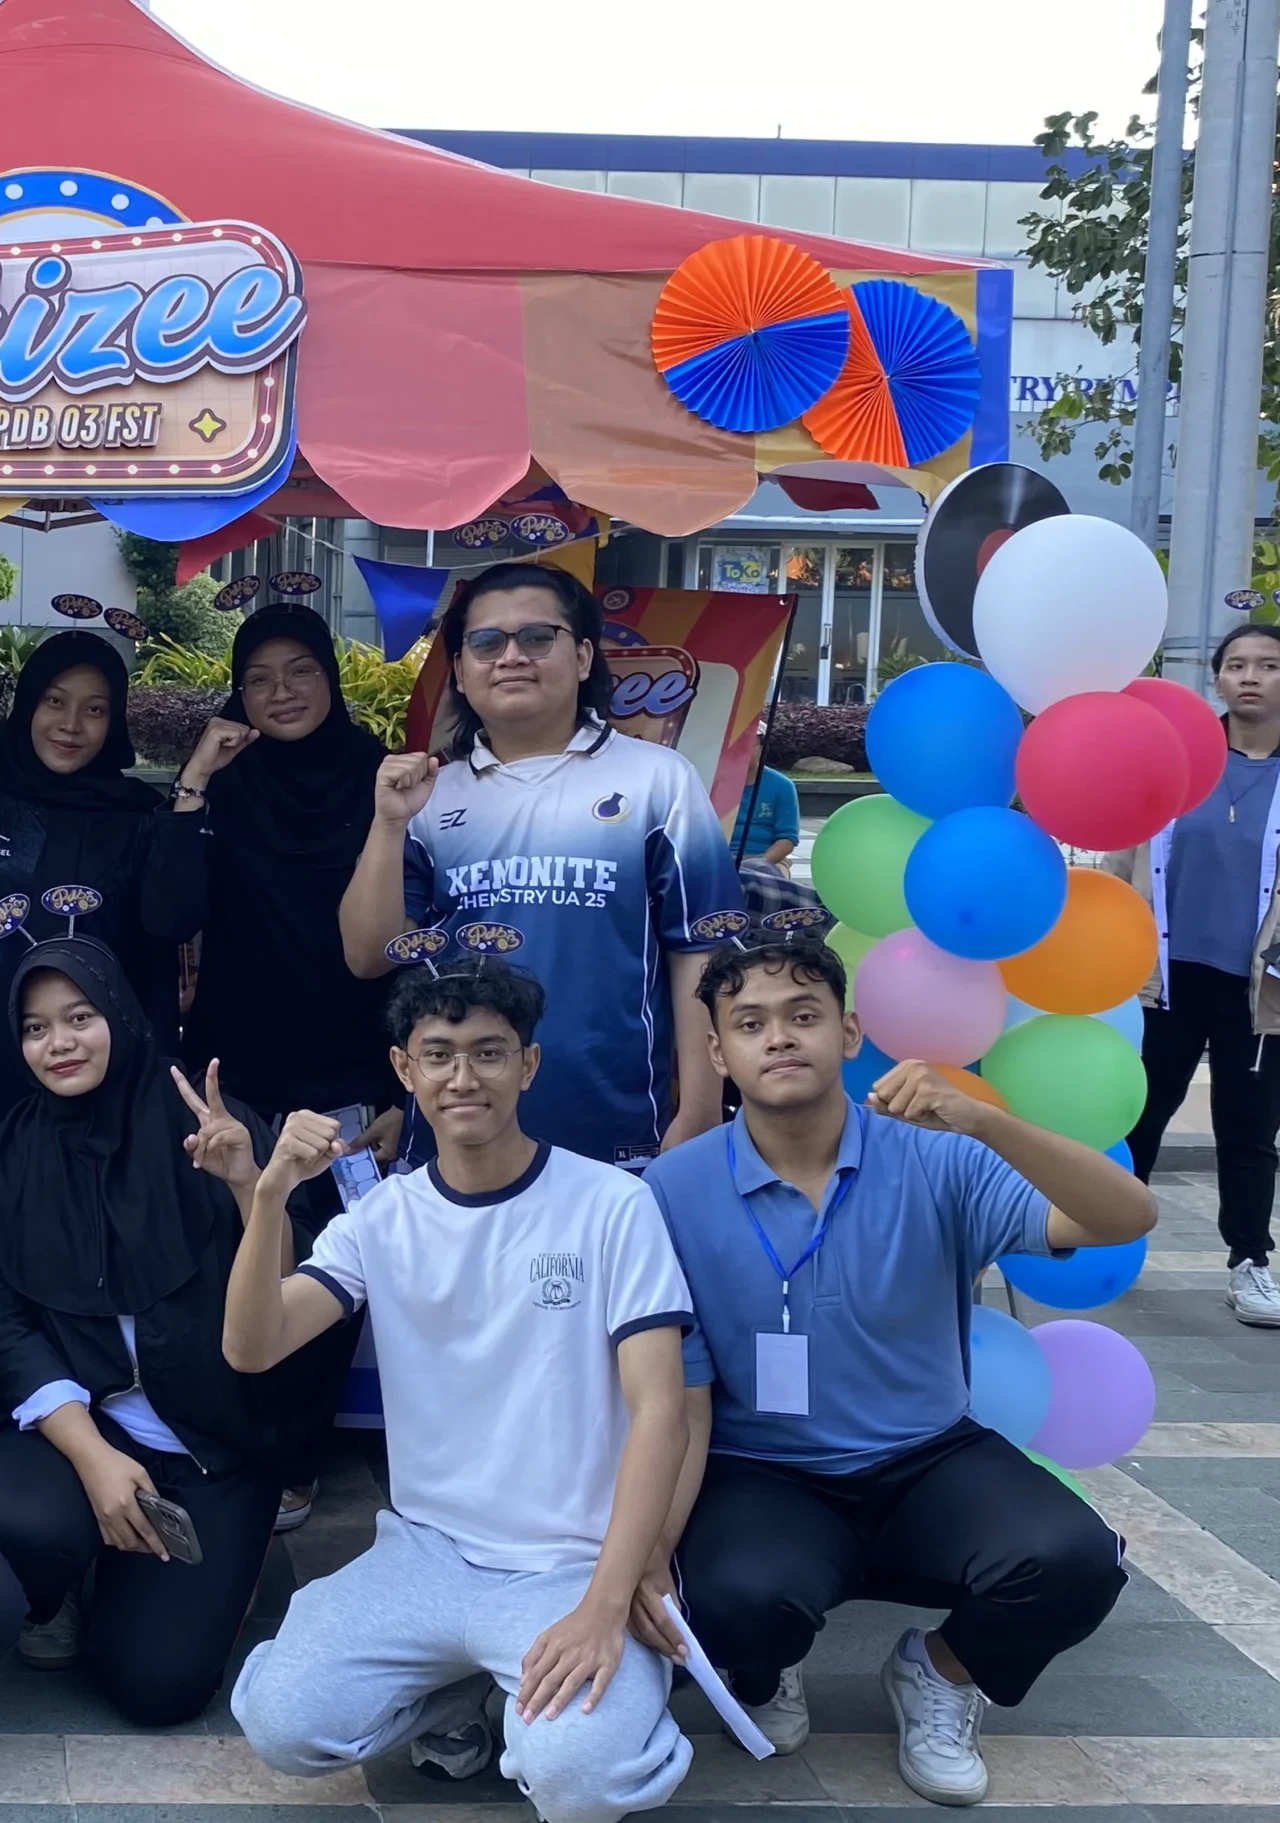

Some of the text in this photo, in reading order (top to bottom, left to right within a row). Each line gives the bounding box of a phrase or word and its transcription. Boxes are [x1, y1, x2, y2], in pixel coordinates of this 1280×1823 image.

[58, 402, 106, 449] 03
[107, 401, 163, 447] FST
[446, 856, 617, 897] XENONITE
[552, 890, 580, 906] UA
[584, 892, 607, 908] 25
[529, 1256, 586, 1283] CALIFORNIA
